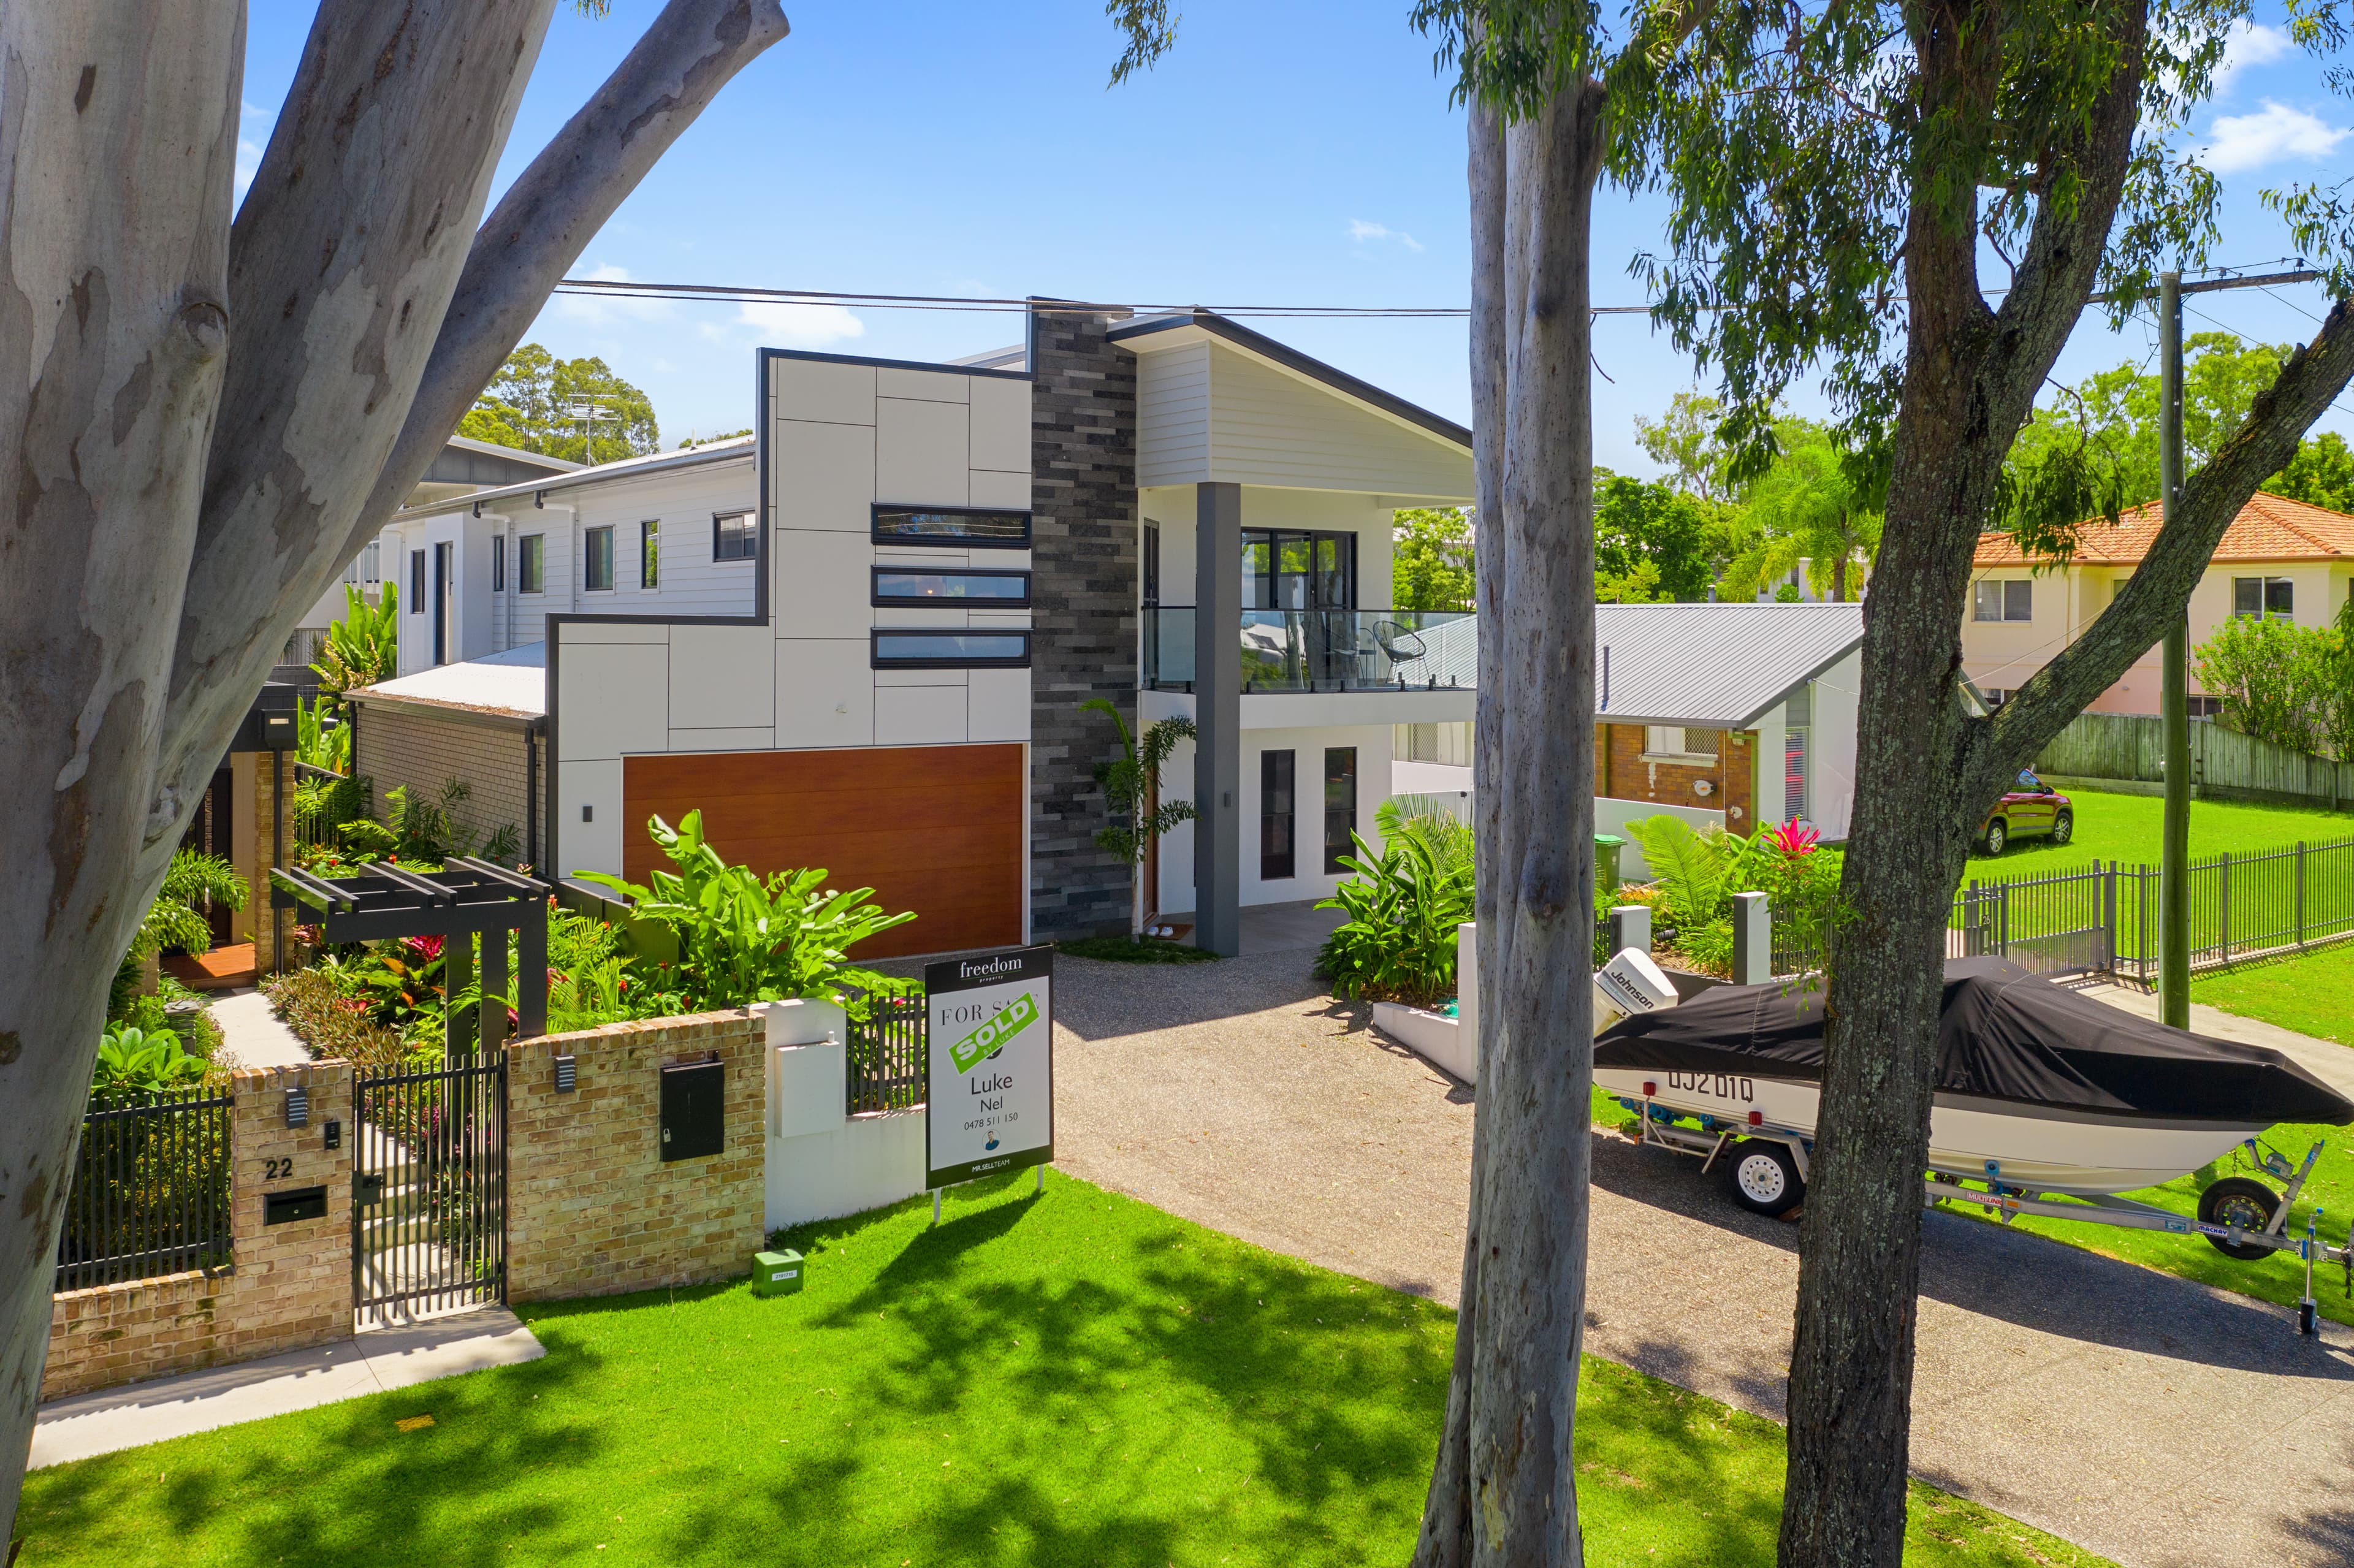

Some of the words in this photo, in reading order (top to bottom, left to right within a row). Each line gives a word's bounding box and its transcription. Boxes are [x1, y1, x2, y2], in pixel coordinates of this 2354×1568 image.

[1983, 915, 1990, 925] 26
[960, 957, 1023, 978] freedom
[1611, 972, 1654, 1009] Johnson
[942, 1004, 982, 1026] FOR
[956, 1000, 1029, 1060] SOLD
[983, 1046, 992, 1055] BY
[995, 1029, 1015, 1046] LUKE
[971, 1073, 1013, 1095] Luke
[981, 1096, 1003, 1113] Nel
[964, 1119, 984, 1130] 0478
[986, 1116, 1000, 1126] 511
[1005, 1112, 1018, 1122] 150
[266, 1158, 292, 1179] 22
[2198, 1225, 2227, 1235] MACKAY
